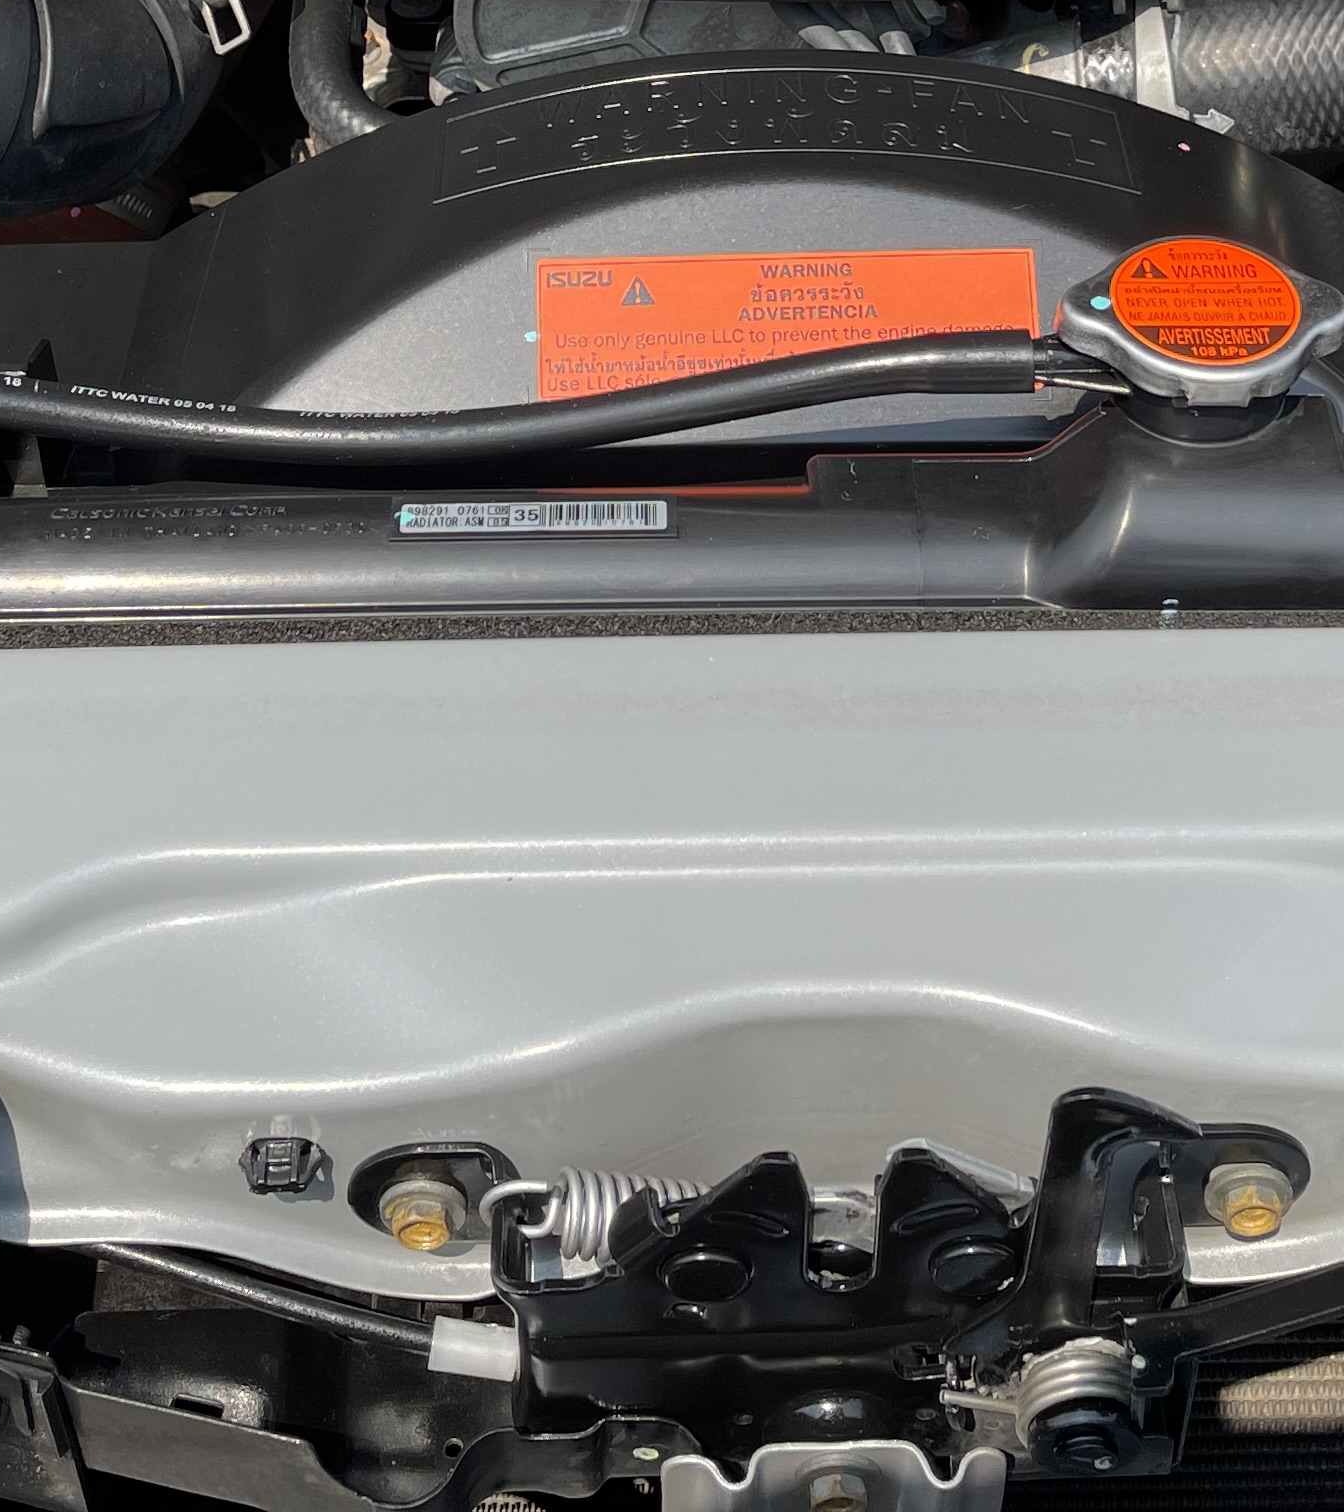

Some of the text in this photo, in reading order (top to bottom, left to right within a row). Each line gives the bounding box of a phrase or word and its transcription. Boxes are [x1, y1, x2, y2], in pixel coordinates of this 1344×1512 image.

[546, 270, 613, 288] ISUZU
[761, 262, 853, 279] WARNING
[1171, 264, 1258, 279] WARNING
[750, 281, 865, 302] ข้อควรระวัง
[1126, 297, 1168, 308] NEVER
[1174, 297, 1208, 308] OPEN
[1213, 297, 1253, 308] WHEN
[738, 304, 879, 322] ADVERTENCIA
[1128, 311, 1143, 322] NE
[1147, 311, 1191, 322] JAMAIS
[1193, 311, 1234, 322] OUVRIR
[1248, 311, 1287, 322] CHAUD
[556, 334, 588, 349] Use
[594, 332, 630, 351] only
[635, 329, 706, 350] genuine
[712, 329, 743, 344] LLC
[749, 328, 766, 343] to
[771, 325, 839, 346] prevent
[844, 323, 872, 341] the
[1158, 327, 1271, 346] AVERTISSEMENT
[1220, 346, 1249, 357] kPa
[3, 376, 22, 387] 18
[547, 376, 580, 392] Use
[587, 375, 619, 391] LLC
[110, 390, 171, 407] WATER
[457, 506, 485, 516] 0761
[513, 509, 539, 522] 35
